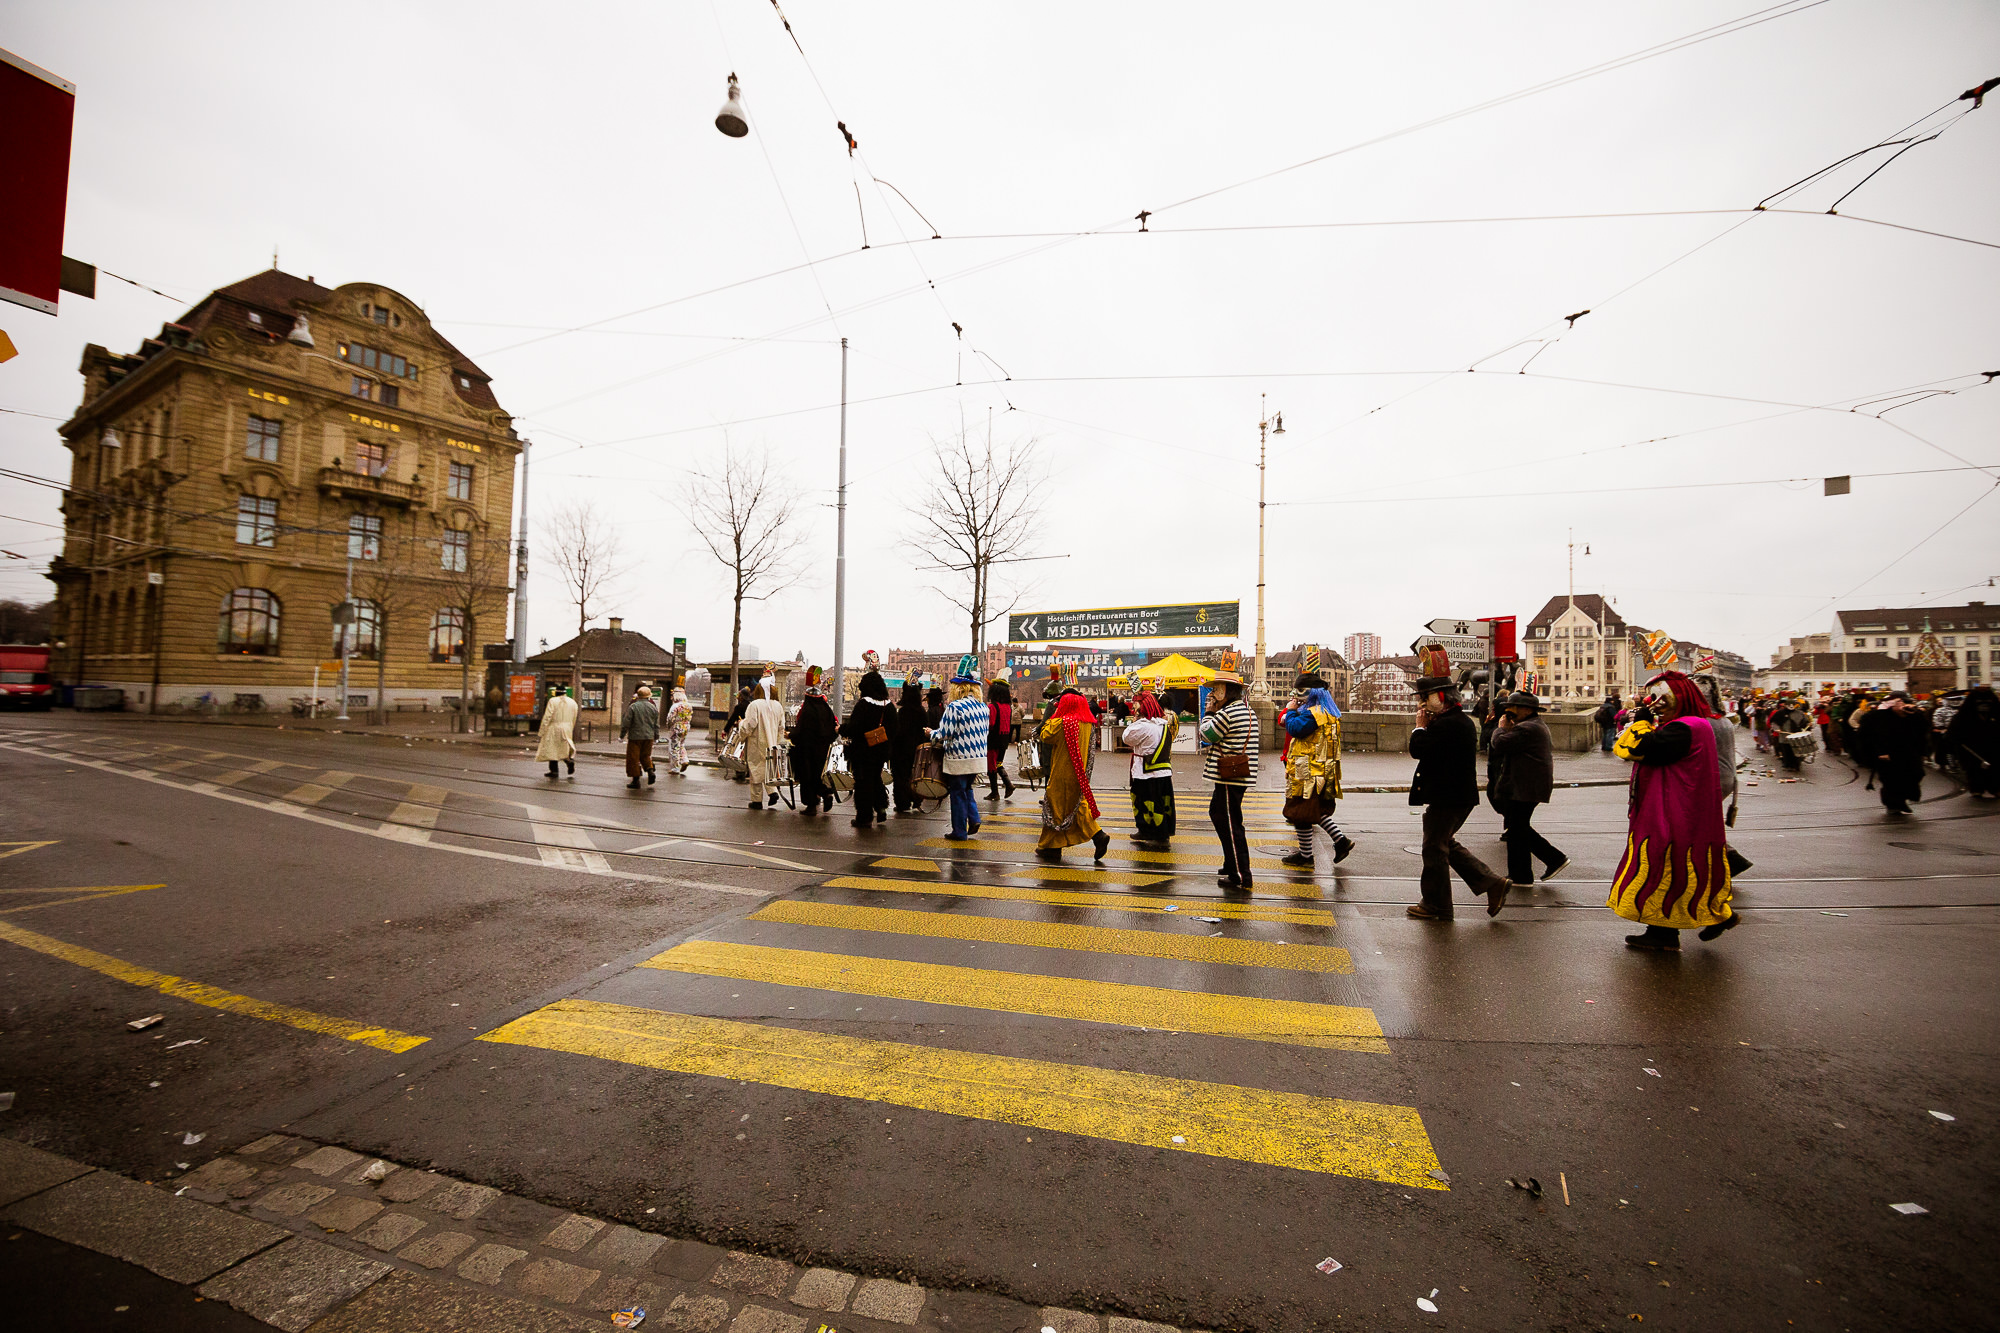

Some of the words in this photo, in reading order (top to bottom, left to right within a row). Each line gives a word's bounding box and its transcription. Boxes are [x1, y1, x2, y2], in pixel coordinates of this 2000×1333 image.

[248, 387, 290, 405] LES
[348, 413, 400, 433] TROIS
[1047, 613, 1085, 623] Hotelschiff
[1086, 612, 1127, 621] Restaurant
[1140, 609, 1159, 618] Bord
[1046, 625, 1067, 638] MS
[1070, 621, 1158, 637] EDELWEISS
[1184, 625, 1220, 633] SCYLLA
[1014, 654, 1081, 666] FASNACHT
[1084, 653, 1110, 665] UFF
[1447, 650, 1485, 661] sitätsspital
